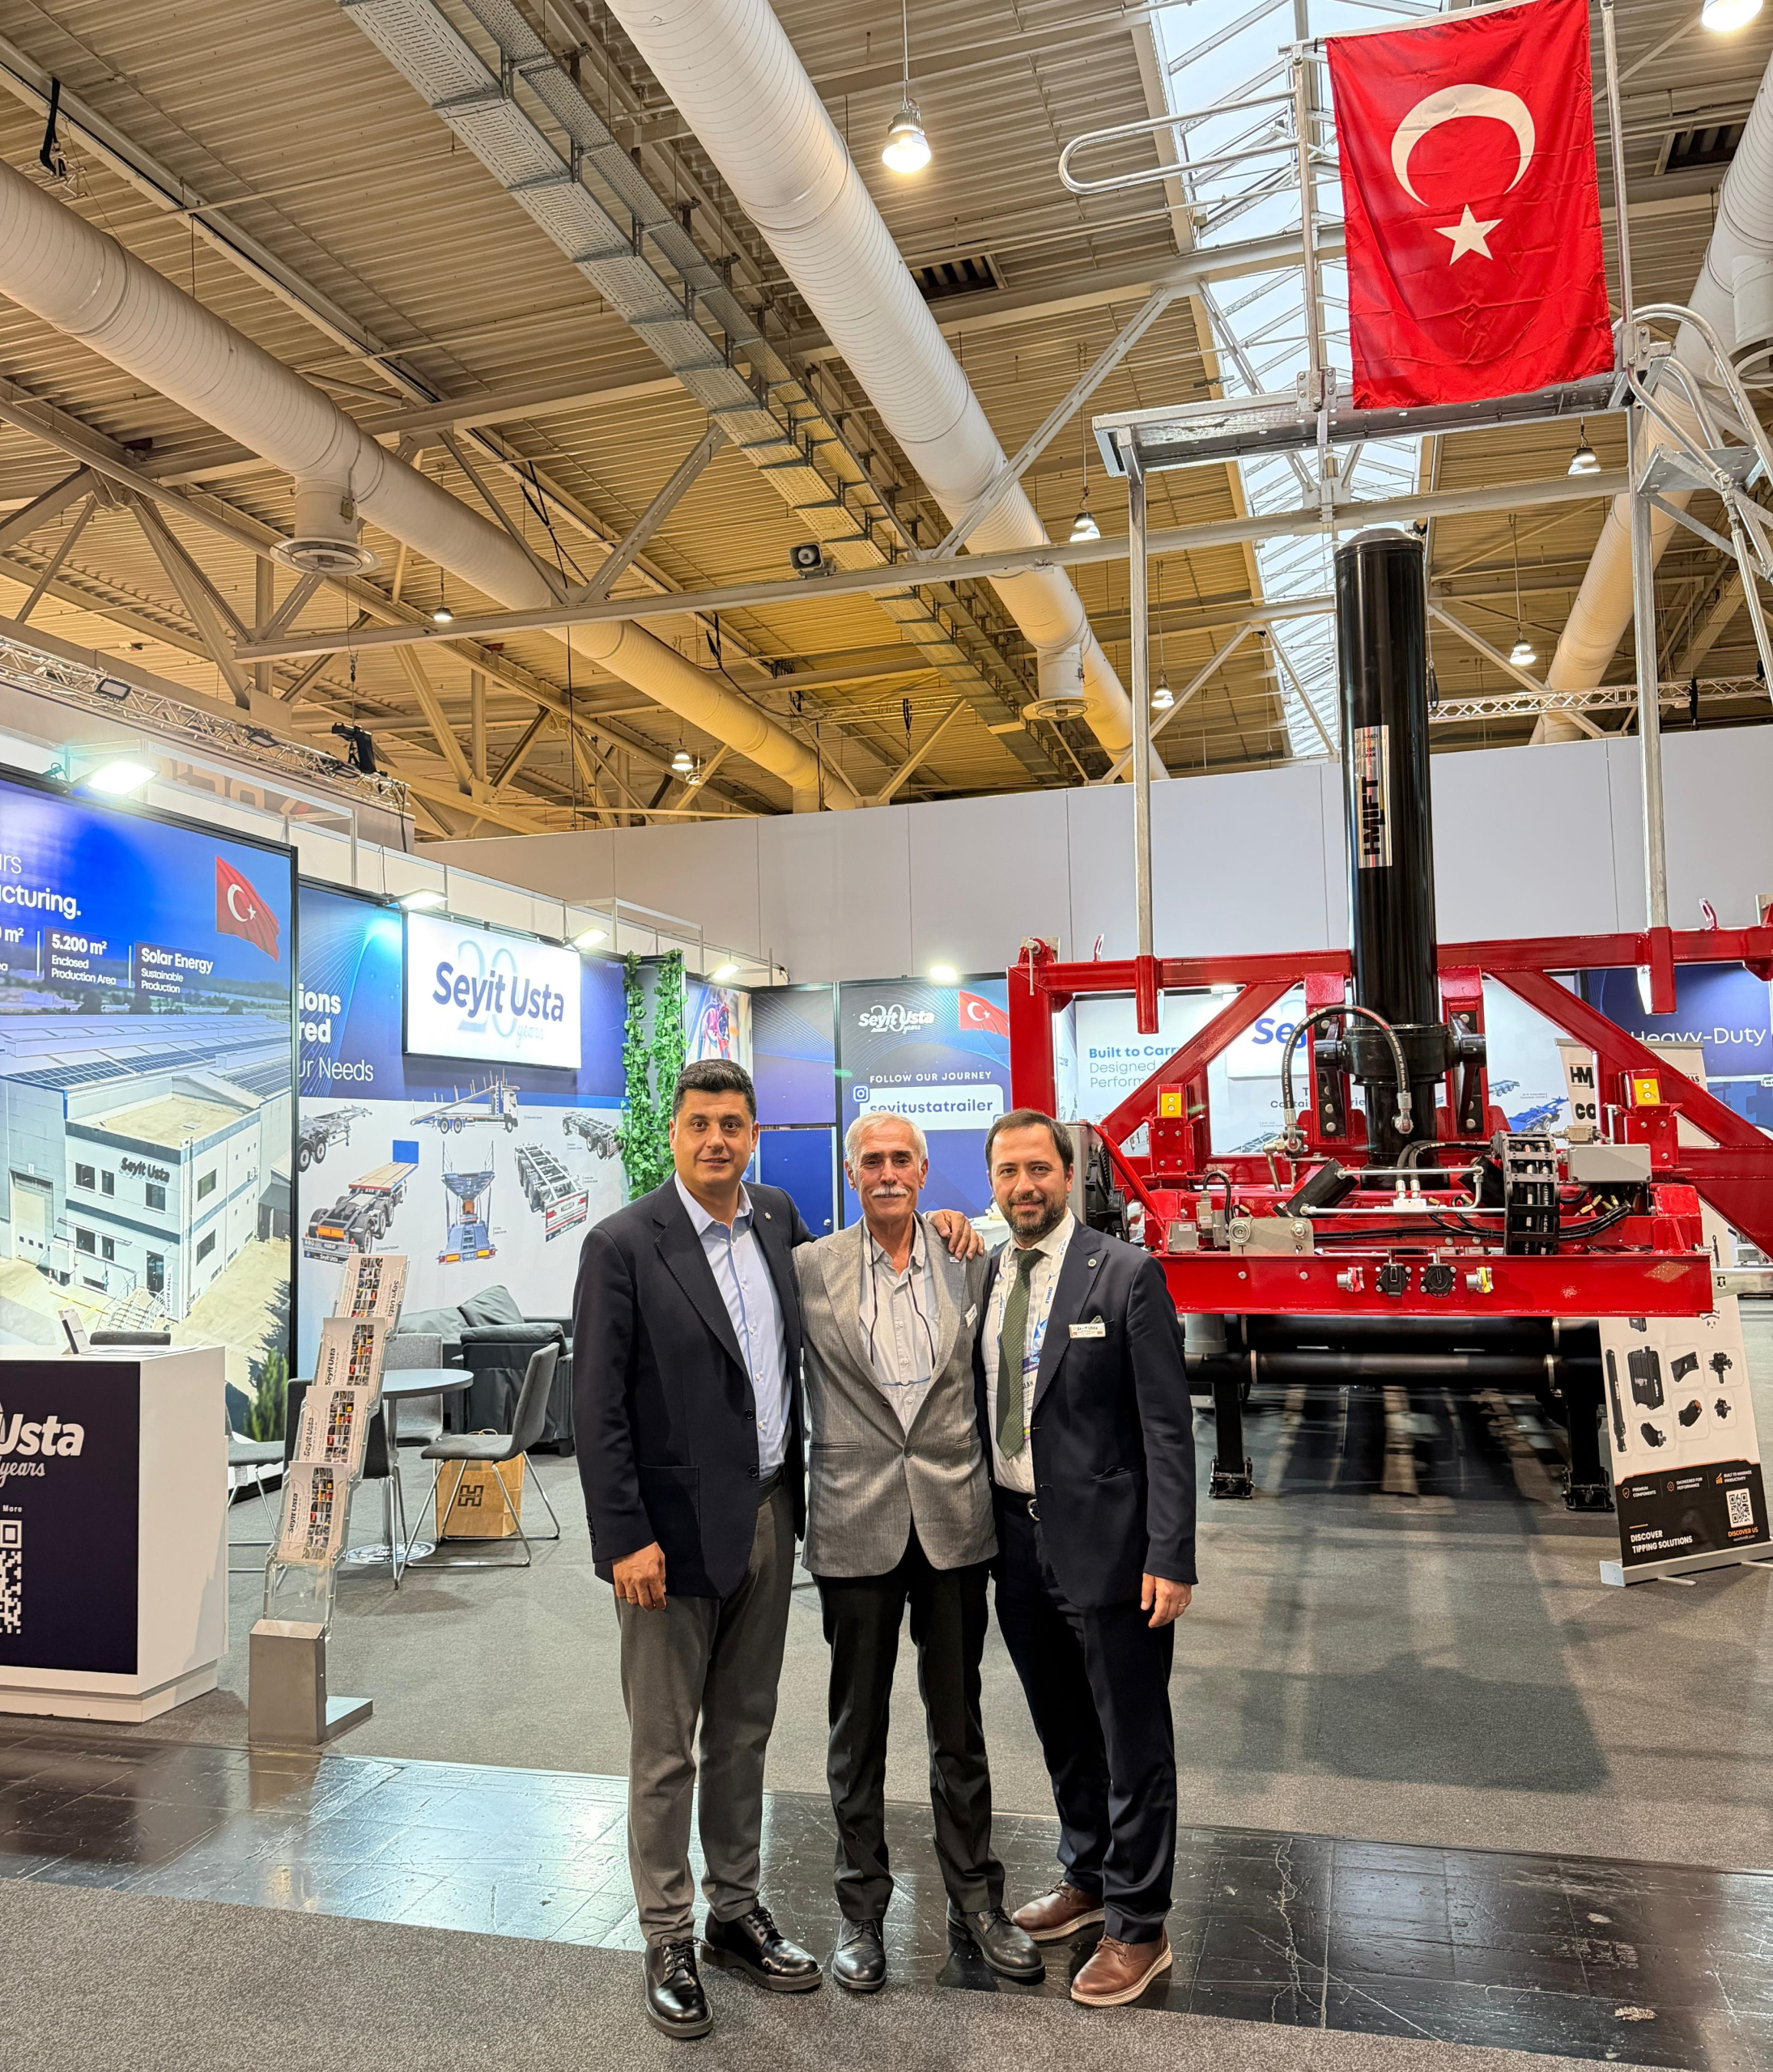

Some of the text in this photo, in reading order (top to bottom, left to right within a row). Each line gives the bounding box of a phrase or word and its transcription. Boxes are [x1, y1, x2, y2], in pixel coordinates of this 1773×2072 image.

[0, 853, 22, 874] rs
[0, 885, 81, 919] cturing.
[51, 933, 88, 953] 5.200
[51, 954, 89, 970] Enclosed
[141, 948, 214, 975] Solar Energy
[51, 968, 117, 986] Production Area
[141, 968, 184, 983] Sustainable
[141, 980, 181, 994] Production
[432, 962, 564, 1022] Seyit Usta
[858, 1010, 935, 1029] Seyit Usta
[1089, 1046, 1180, 1059] Built to Carr
[319, 1056, 374, 1081] Needs
[1090, 1060, 1156, 1074] Designed
[869, 1071, 992, 1084] FOLLOW OUR JOURNEY
[0, 1413, 85, 1457] Usta
[0, 1460, 46, 1488] years
[2, 1504, 23, 1513] More
[1631, 1530, 1663, 1543] DISCOVER
[1728, 1528, 1751, 1537] DISCOVER
[1631, 1535, 1693, 1554] TIPPING SOLUTIONS
